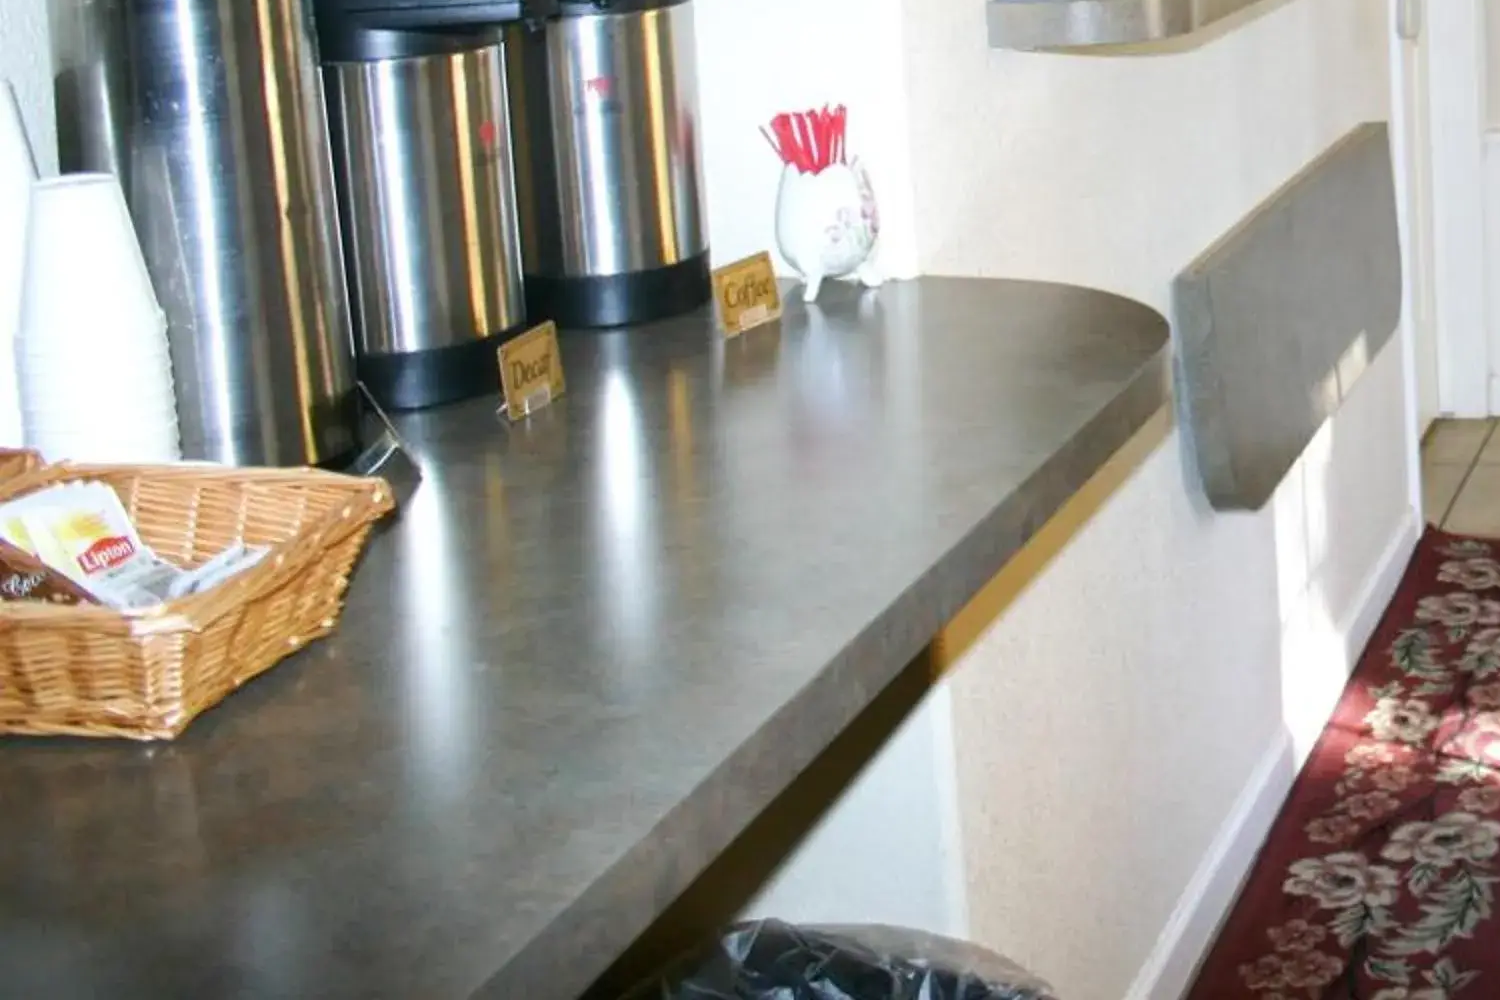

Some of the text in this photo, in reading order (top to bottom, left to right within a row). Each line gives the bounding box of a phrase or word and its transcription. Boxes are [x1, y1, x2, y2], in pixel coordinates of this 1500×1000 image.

[723, 271, 771, 310] Coffee
[509, 352, 553, 391] Decaf
[80, 541, 135, 570] Lipton
